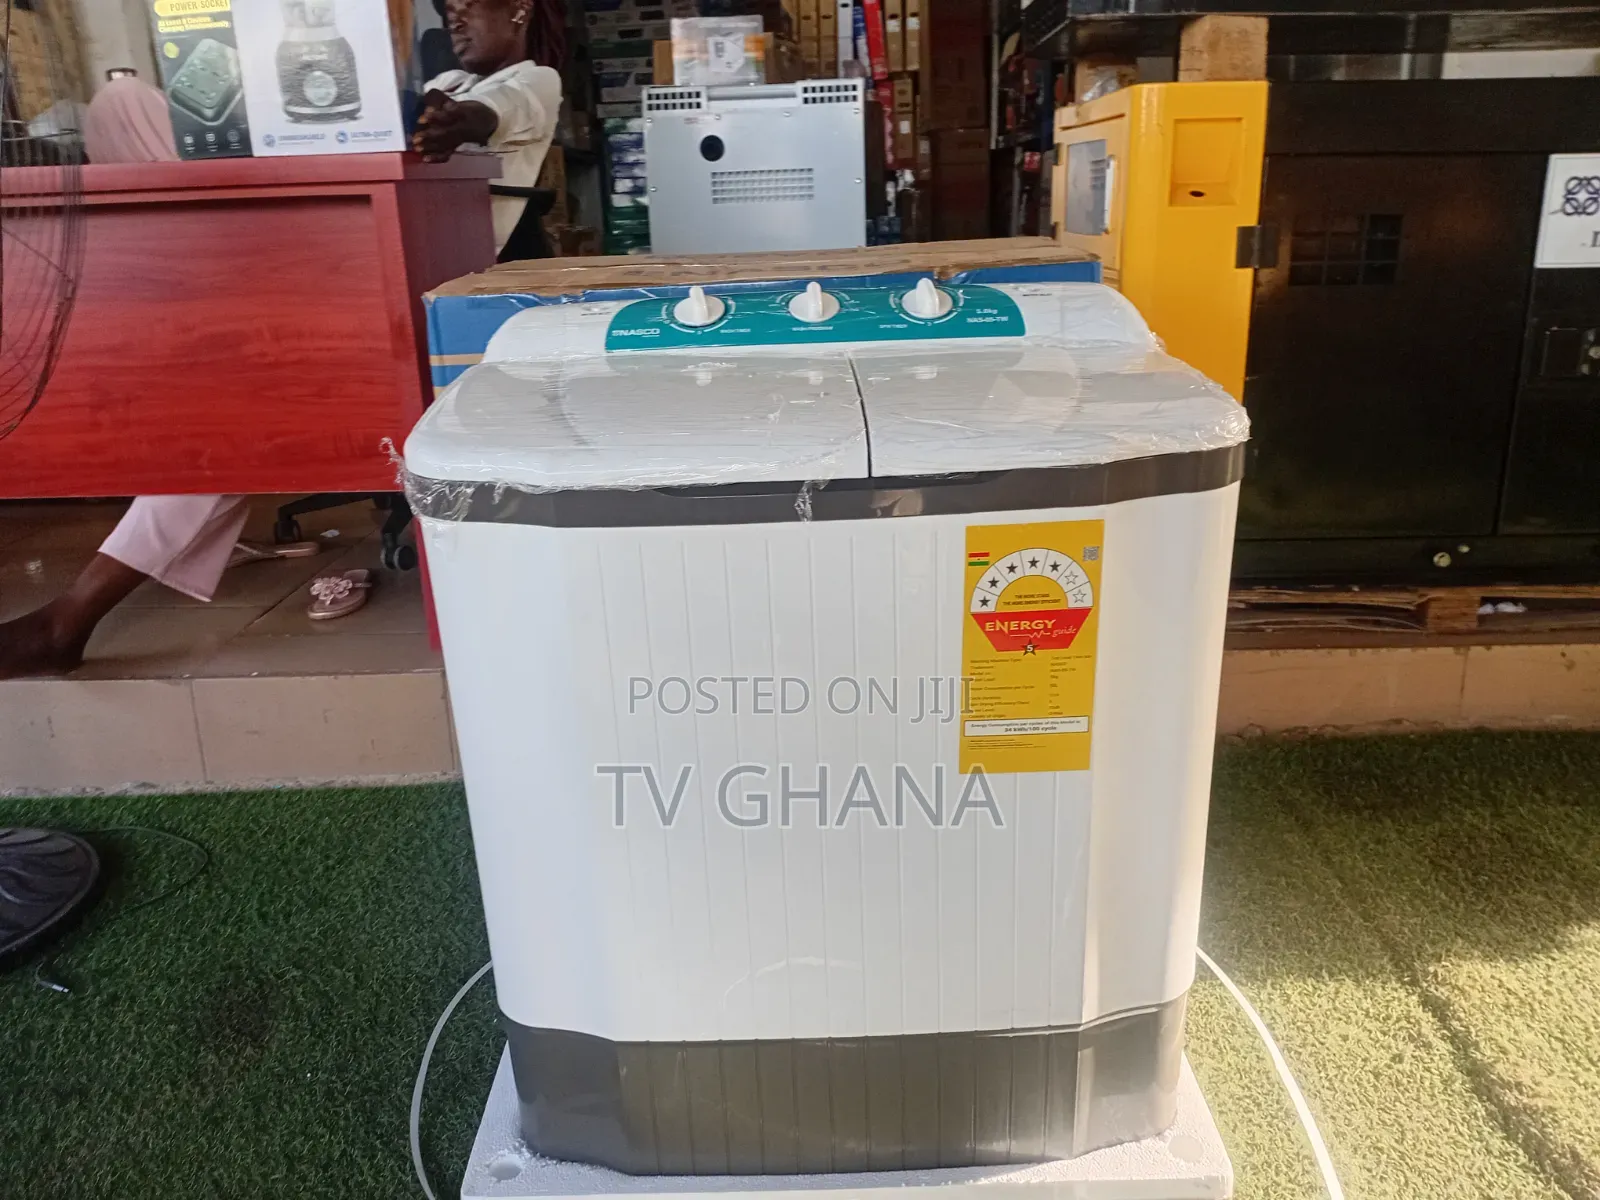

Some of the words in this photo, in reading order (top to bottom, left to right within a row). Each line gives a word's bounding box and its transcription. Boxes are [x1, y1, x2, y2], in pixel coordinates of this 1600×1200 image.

[170, 1, 198, 12] POWER
[985, 619, 1057, 634] ENERGY
[1052, 625, 1077, 638] guide
